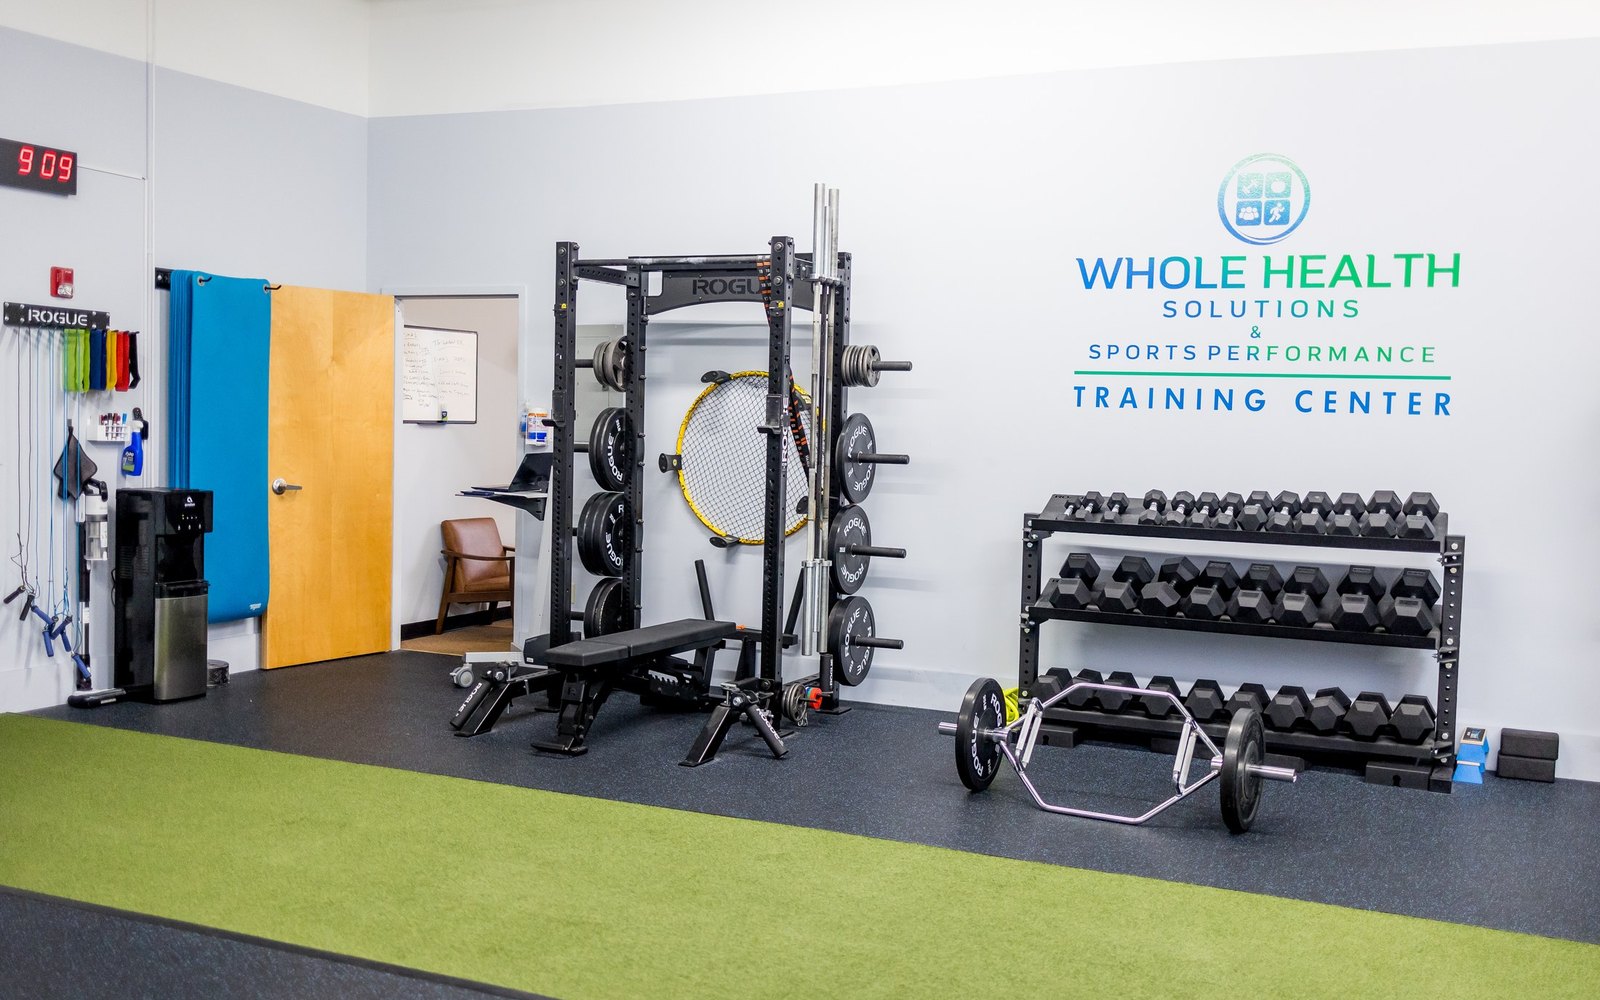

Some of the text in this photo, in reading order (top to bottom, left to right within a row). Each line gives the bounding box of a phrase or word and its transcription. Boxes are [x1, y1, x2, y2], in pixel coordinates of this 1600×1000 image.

[1076, 252, 1461, 290] WHOLE HEALTH
[692, 278, 760, 295] ROGU
[28, 308, 88, 327] ROGUE
[1162, 299, 1360, 319] SOLUTIONS
[1250, 325, 1262, 339] &
[1089, 344, 1436, 364] SPORTS PERFORMANCE
[1074, 386, 1452, 417] TRAINING CENTER
[848, 425, 868, 458] ROGUE
[843, 517, 867, 537] ROGUE
[605, 532, 624, 567] OGUE
[840, 563, 865, 583] ROGUE
[844, 607, 861, 657] ROGUE
[971, 712, 984, 777] ROGUE
